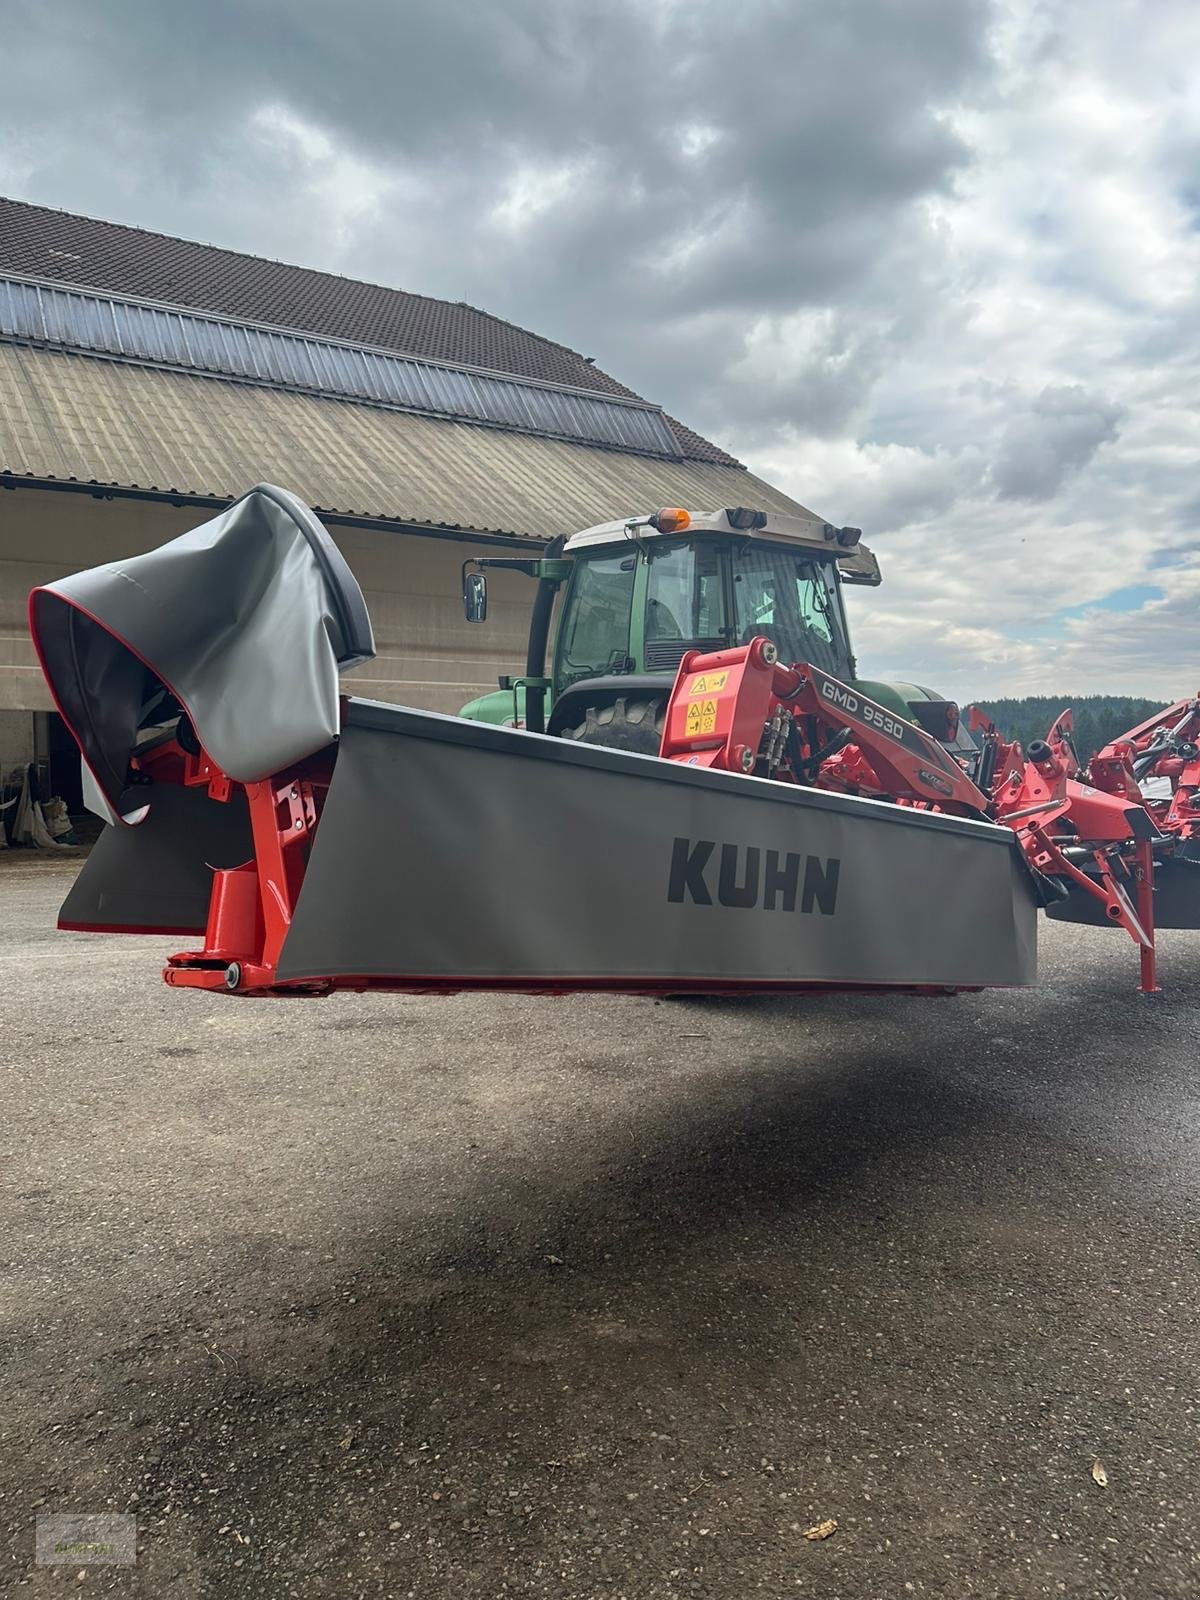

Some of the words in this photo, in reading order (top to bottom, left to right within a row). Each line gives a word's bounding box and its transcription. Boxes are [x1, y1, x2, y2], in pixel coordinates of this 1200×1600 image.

[822, 681, 859, 713] GMD
[863, 705, 904, 739] 9530
[668, 837, 841, 915] KUHN
